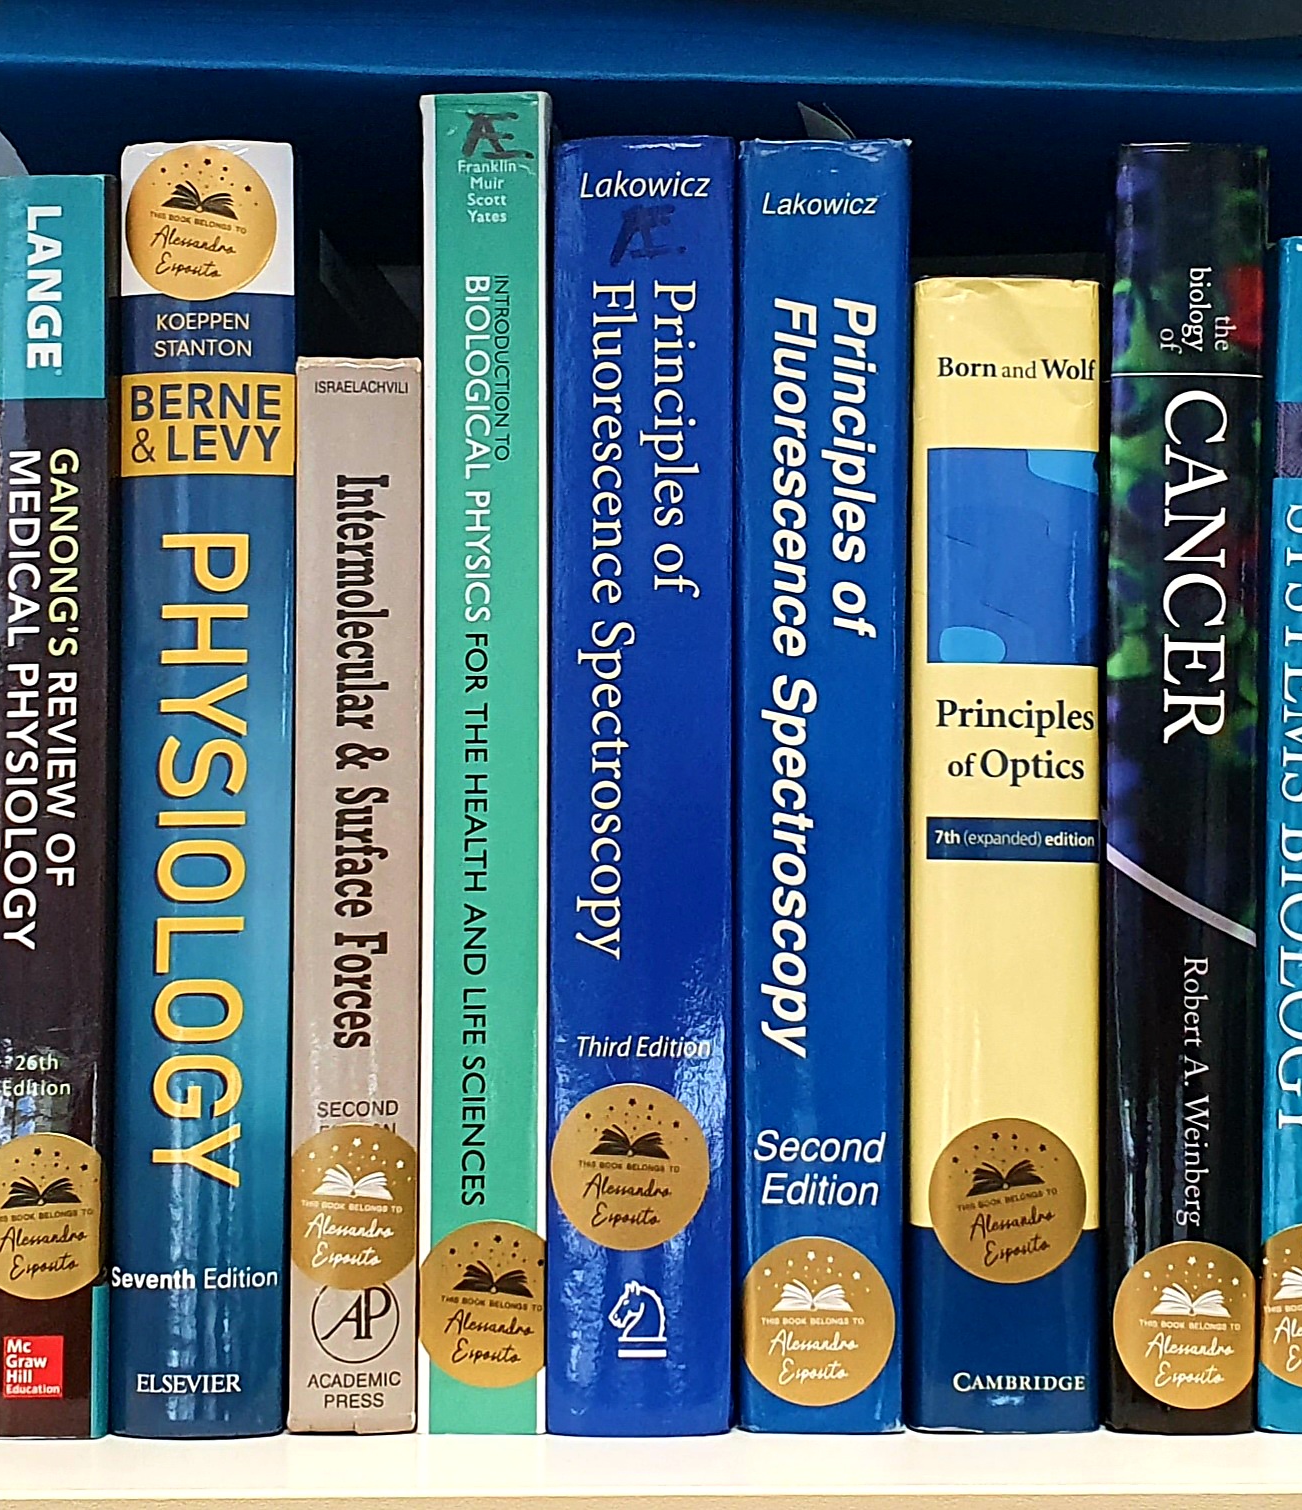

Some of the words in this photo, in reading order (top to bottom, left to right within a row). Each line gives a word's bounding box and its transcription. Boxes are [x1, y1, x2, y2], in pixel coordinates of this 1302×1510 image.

[457, 160, 517, 173] Franklin
[469, 176, 504, 190] Muir
[580, 172, 710, 198] Lakowicz
[467, 192, 507, 208] Scott
[761, 191, 876, 217] Lakowicz
[169, 214, 192, 225] BOOK
[466, 209, 507, 224] Yates
[150, 224, 237, 254] Alessandro
[156, 312, 250, 332] KOEPPEN
[1179, 267, 1210, 352] biology
[1160, 327, 1182, 354] of
[1214, 315, 1231, 350] the
[154, 337, 252, 358] STANTON
[493, 274, 510, 427] INTRODUCTION
[937, 356, 996, 379] Born
[1001, 359, 1036, 378] and
[1041, 357, 1095, 381] Wolf
[314, 380, 409, 395] ISRAELACHVILI
[131, 384, 282, 420] BERNE
[823, 297, 876, 564] Principles
[132, 434, 155, 463] &
[168, 426, 279, 462] LEVY
[495, 434, 510, 461] TO
[771, 296, 818, 657] Fluorescence
[1162, 390, 1228, 743] CANCER
[830, 584, 877, 637] of
[935, 831, 961, 846] 7th
[963, 831, 1042, 849] (expanded)
[1045, 832, 1095, 847] edition
[153, 532, 249, 1189] PHYSIOLOGY
[759, 673, 818, 1058] Spectroscopy
[1183, 956, 1208, 1047] Robert
[1184, 1055, 1207, 1088] A.
[316, 1099, 398, 1118] SECOND
[1175, 1096, 1209, 1228] Weinberg
[7, 1339, 31, 1354] Mc
[1144, 1334, 1234, 1360] Alessandro
[6, 1354, 48, 1369] Graw
[5, 1383, 61, 1396] Education
[6, 1369, 34, 1384] Hill
[136, 1373, 241, 1393] ELSEVIER
[308, 1371, 400, 1388] ACADEMIC
[952, 1371, 1085, 1393] CAMBRIDGE
[324, 1392, 384, 1408] PRESS
